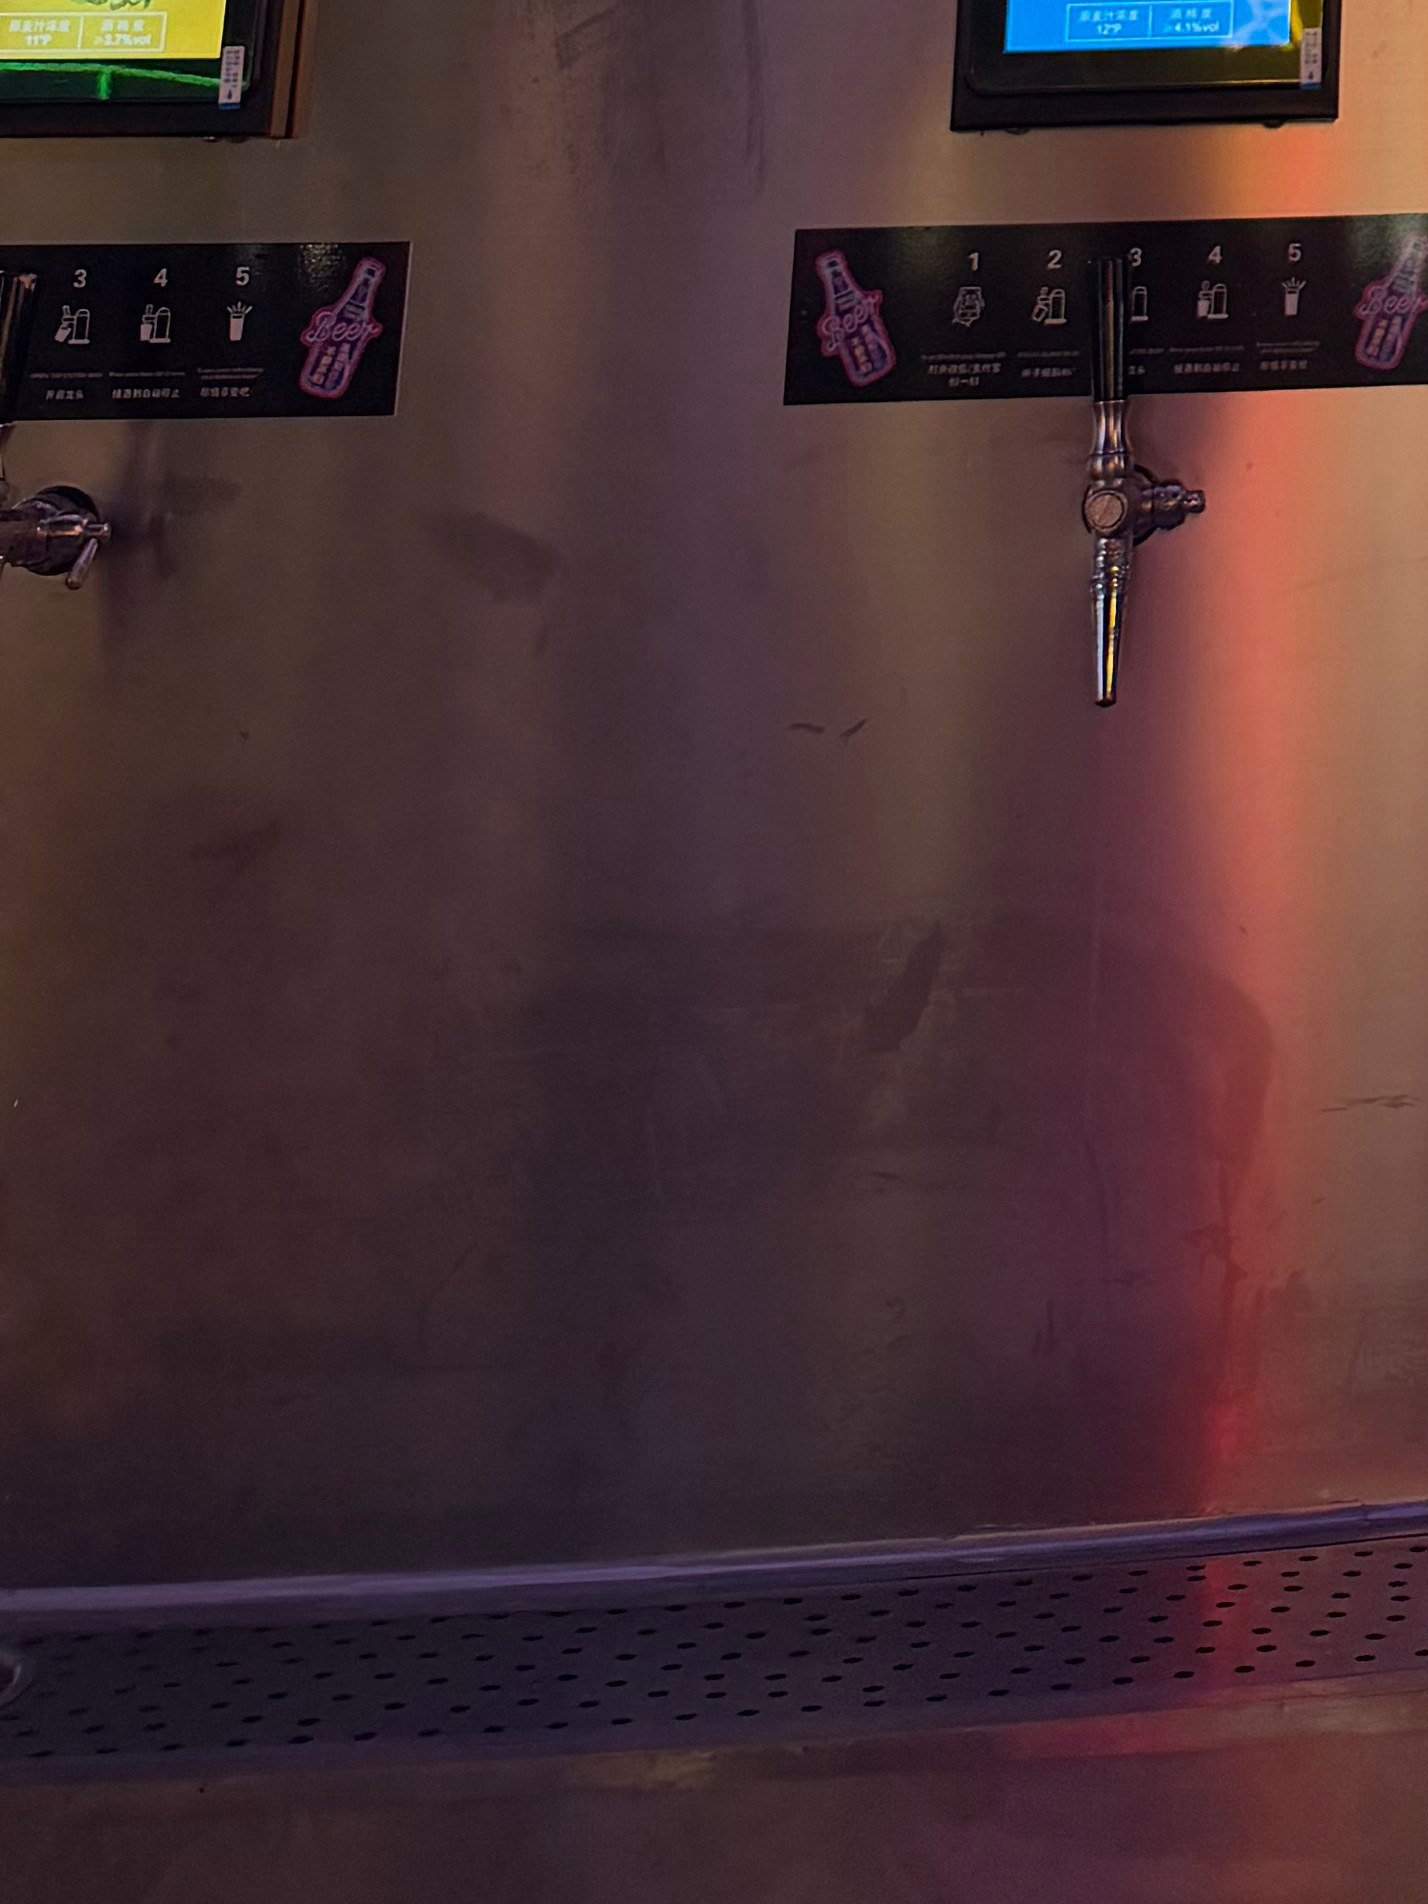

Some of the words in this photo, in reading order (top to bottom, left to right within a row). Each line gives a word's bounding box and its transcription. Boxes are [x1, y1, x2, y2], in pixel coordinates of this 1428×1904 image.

[969, 252, 979, 270] 1
[1047, 250, 1061, 269] 2
[1129, 248, 1142, 266] 3
[1208, 246, 1222, 264] 4
[1288, 243, 1301, 262] 5
[73, 269, 87, 288] 3
[153, 268, 168, 287] 4
[235, 267, 250, 286] 5
[306, 309, 382, 342] Beer
